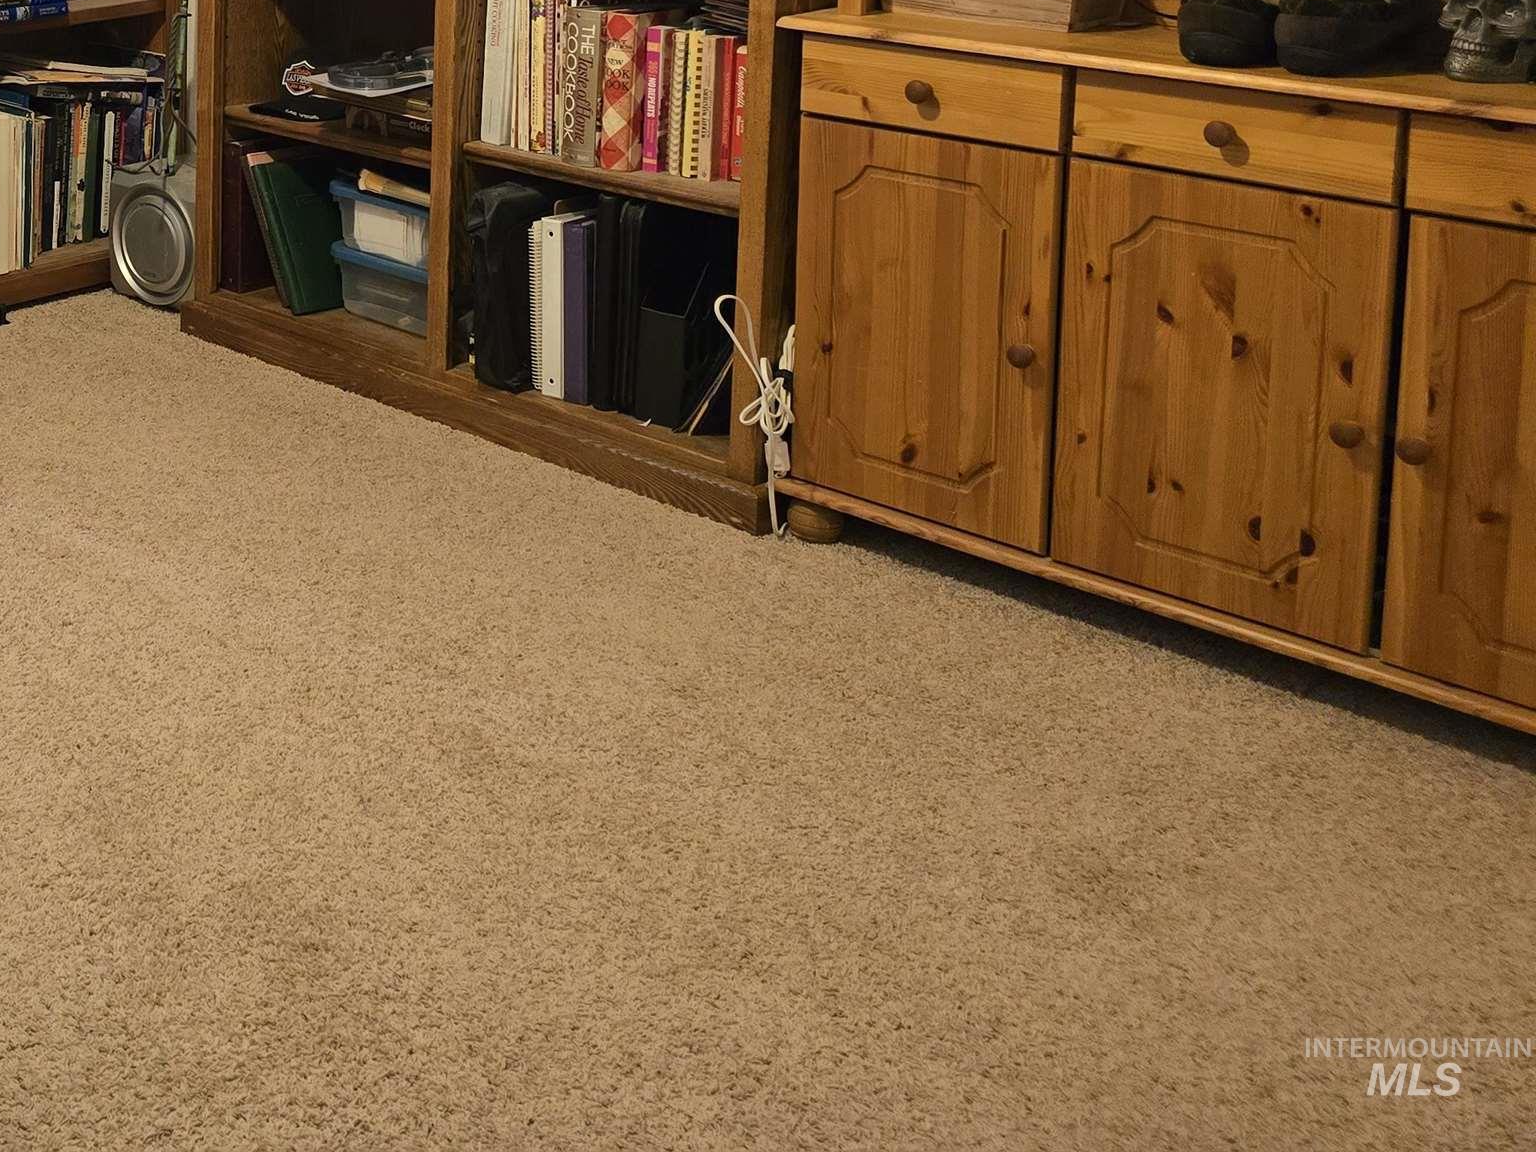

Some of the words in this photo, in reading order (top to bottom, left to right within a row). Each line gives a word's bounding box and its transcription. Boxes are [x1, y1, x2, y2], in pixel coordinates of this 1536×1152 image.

[489, 10, 498, 47] COOKING
[580, 24, 596, 55] THE
[576, 55, 595, 89] Taste
[607, 58, 624, 66] NEW
[563, 22, 579, 143] COOKBOOK
[576, 90, 591, 102] of
[736, 65, 747, 108] Campbell's
[646, 88, 657, 118] REPEATS
[573, 102, 593, 145] Home
